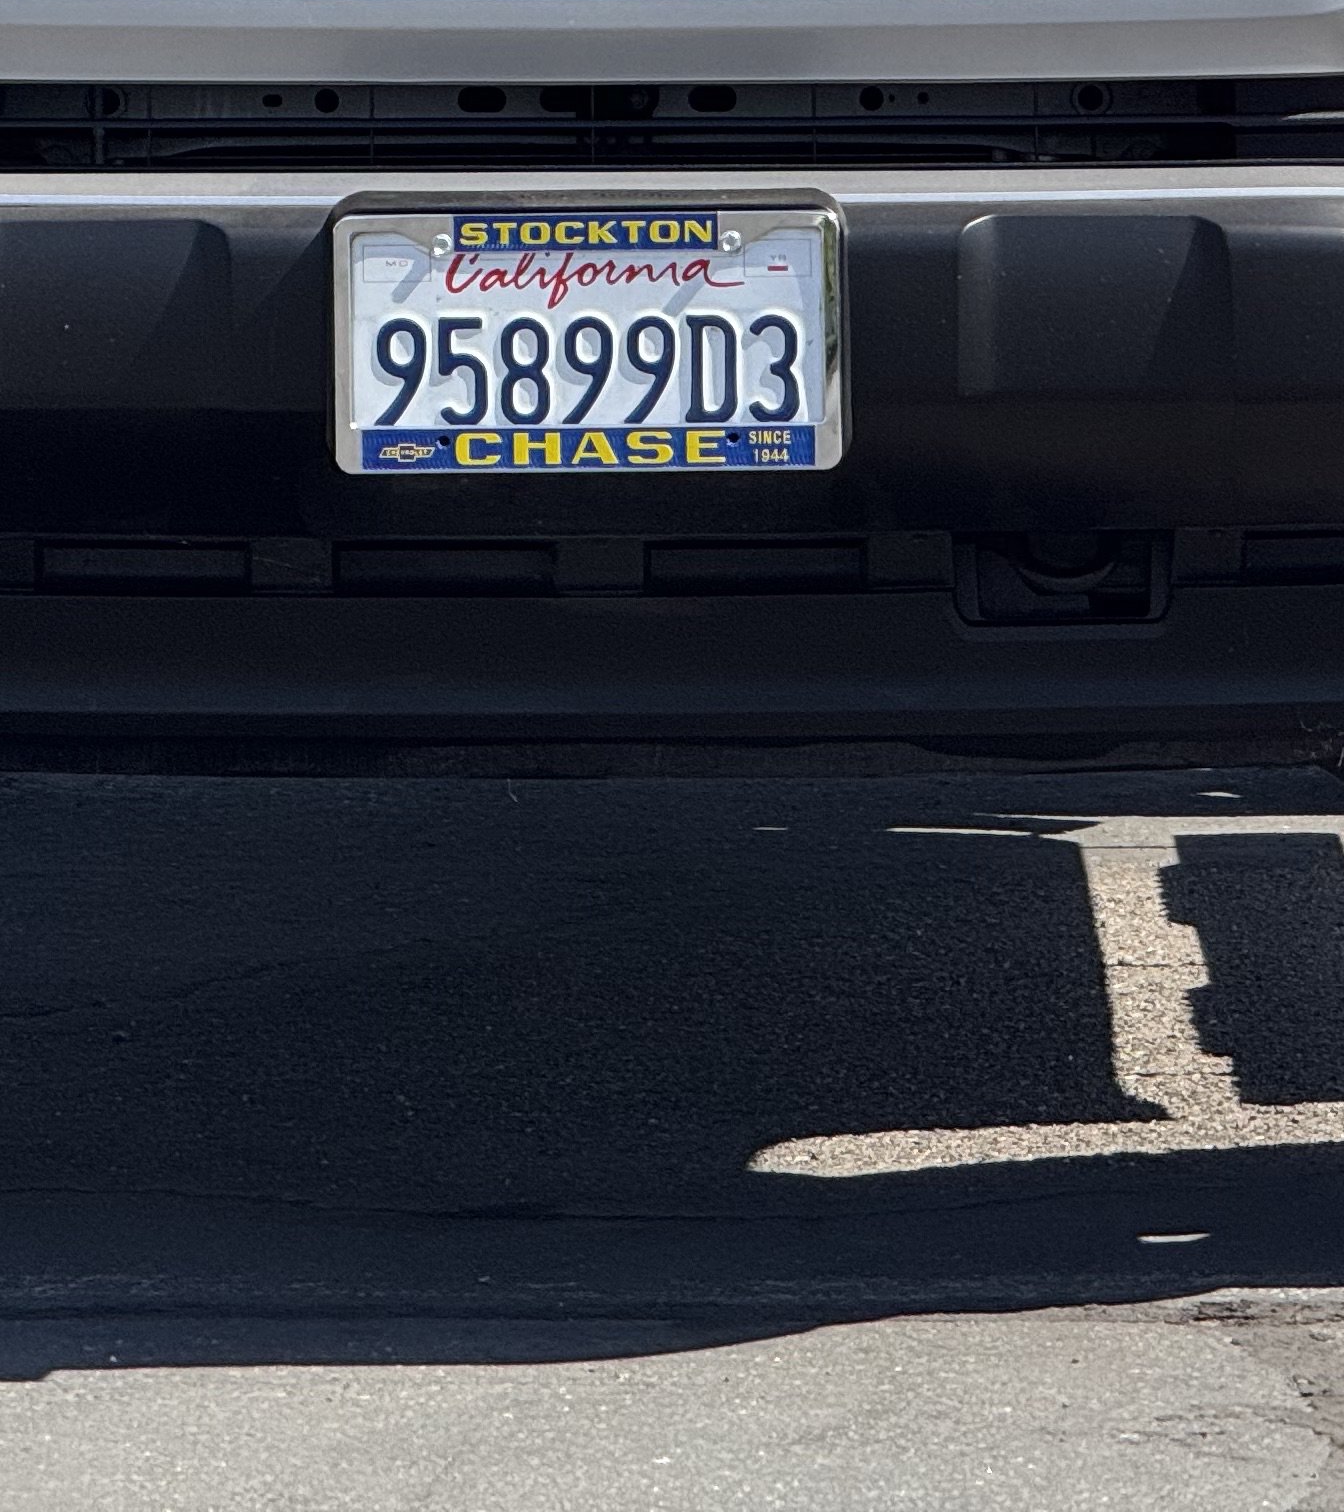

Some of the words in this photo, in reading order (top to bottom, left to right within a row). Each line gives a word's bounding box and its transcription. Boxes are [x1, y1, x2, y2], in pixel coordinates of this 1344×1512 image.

[459, 220, 713, 246] STOCKTON
[445, 252, 745, 309] California
[374, 315, 799, 426] 95899D3
[455, 431, 726, 466] CHASE
[748, 430, 792, 445] SINCE
[752, 448, 790, 463] 1944
